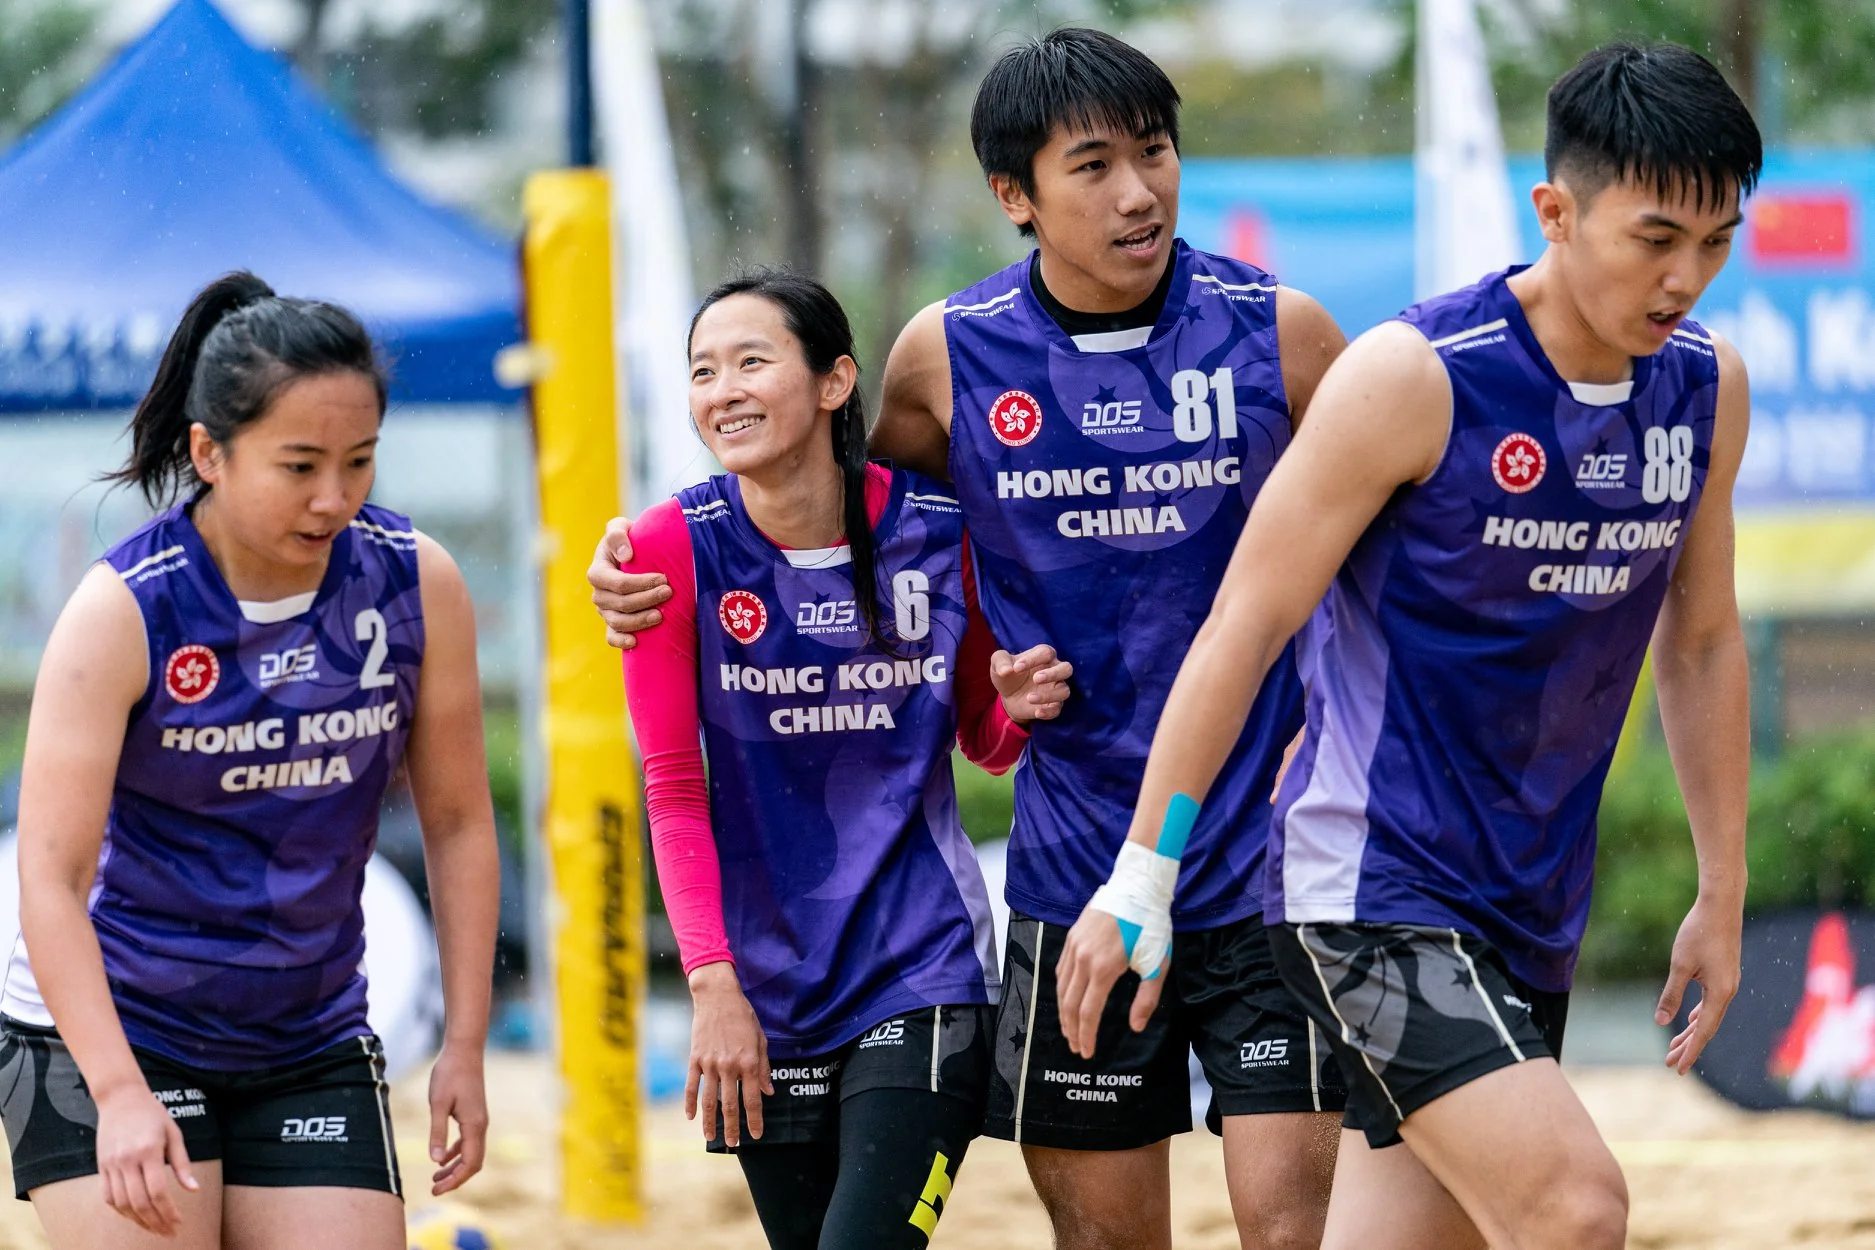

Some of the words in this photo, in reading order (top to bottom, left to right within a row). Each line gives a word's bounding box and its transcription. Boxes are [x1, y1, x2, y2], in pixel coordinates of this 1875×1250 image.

[1082, 400, 1143, 428] DOS
[1170, 366, 1238, 443] 81
[1082, 425, 1144, 436] SPORTSWEAR
[997, 467, 1111, 500] HONG
[1124, 456, 1241, 493] KONG
[1576, 454, 1628, 480] DOS
[1641, 425, 1694, 504] 88
[910, 502, 962, 513] SPORTSWEA
[1057, 505, 1187, 539] CHINA
[1481, 515, 1591, 551] HONG
[1596, 519, 1682, 551] KONG
[1528, 564, 1631, 595] CHINA
[796, 600, 857, 627] DOS
[892, 569, 931, 642] 6
[796, 624, 858, 635] SPORTSWEAR
[259, 643, 317, 680] DOS
[354, 607, 396, 691] 2
[720, 664, 824, 695] HONG
[838, 655, 947, 691] KONG
[161, 718, 285, 755] HONG
[298, 701, 398, 746] KONG
[769, 703, 896, 734] CHINA
[220, 755, 354, 793] CHINA
[859, 1039, 905, 1050] SPORTSWEAR
[1240, 1038, 1289, 1062] DOS
[1044, 1069, 1092, 1086] HONG
[1096, 1074, 1143, 1087] KONG
[1240, 1058, 1290, 1070] SPORTSWEAR
[152, 1089, 184, 1103] ONG
[1065, 1089, 1118, 1103] CHINA
[280, 1116, 347, 1137] DOS
